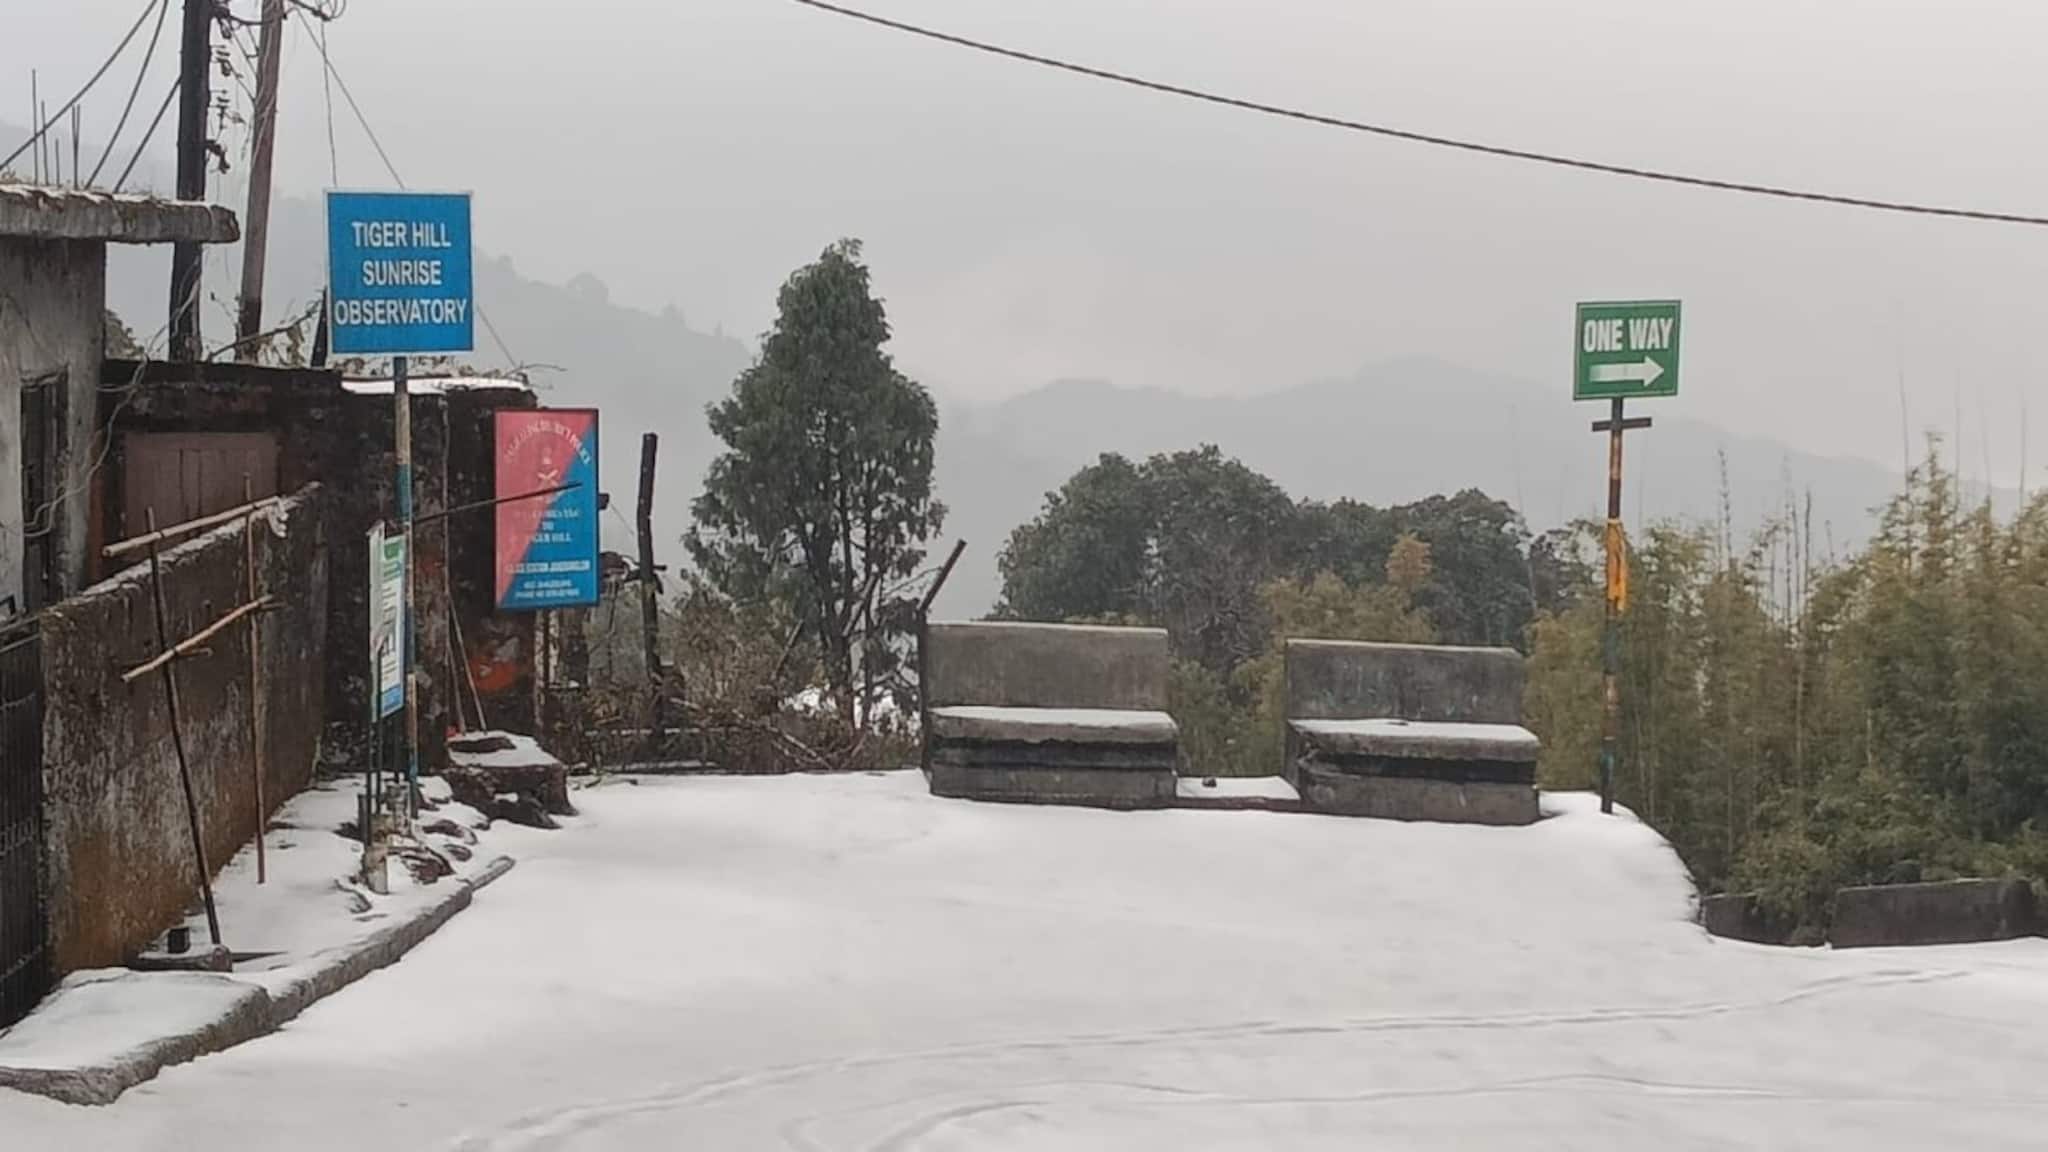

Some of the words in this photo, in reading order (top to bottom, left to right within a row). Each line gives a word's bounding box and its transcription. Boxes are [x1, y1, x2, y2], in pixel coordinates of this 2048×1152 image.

[352, 221, 408, 247] TIGER
[412, 222, 452, 247] HILL
[362, 260, 443, 286] SUNRISE
[334, 298, 467, 325] OBSERVATORY
[1583, 319, 1624, 352] ONE
[1628, 318, 1673, 350] WAY
